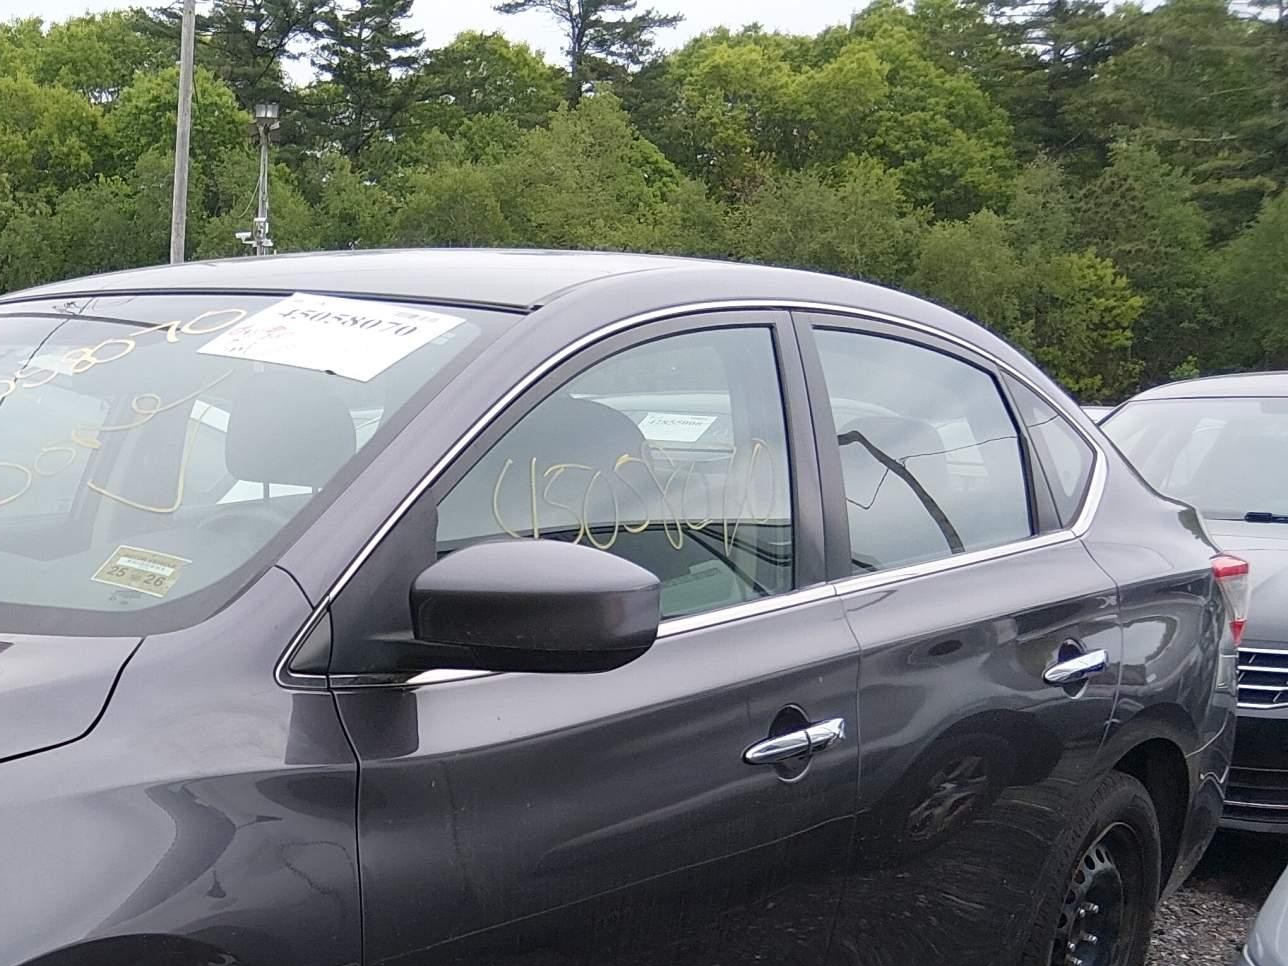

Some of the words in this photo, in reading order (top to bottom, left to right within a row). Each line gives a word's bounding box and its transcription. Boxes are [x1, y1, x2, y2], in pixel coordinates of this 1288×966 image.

[278, 308, 418, 336] 45058070
[107, 566, 128, 577] 25
[143, 574, 166, 587] 26
